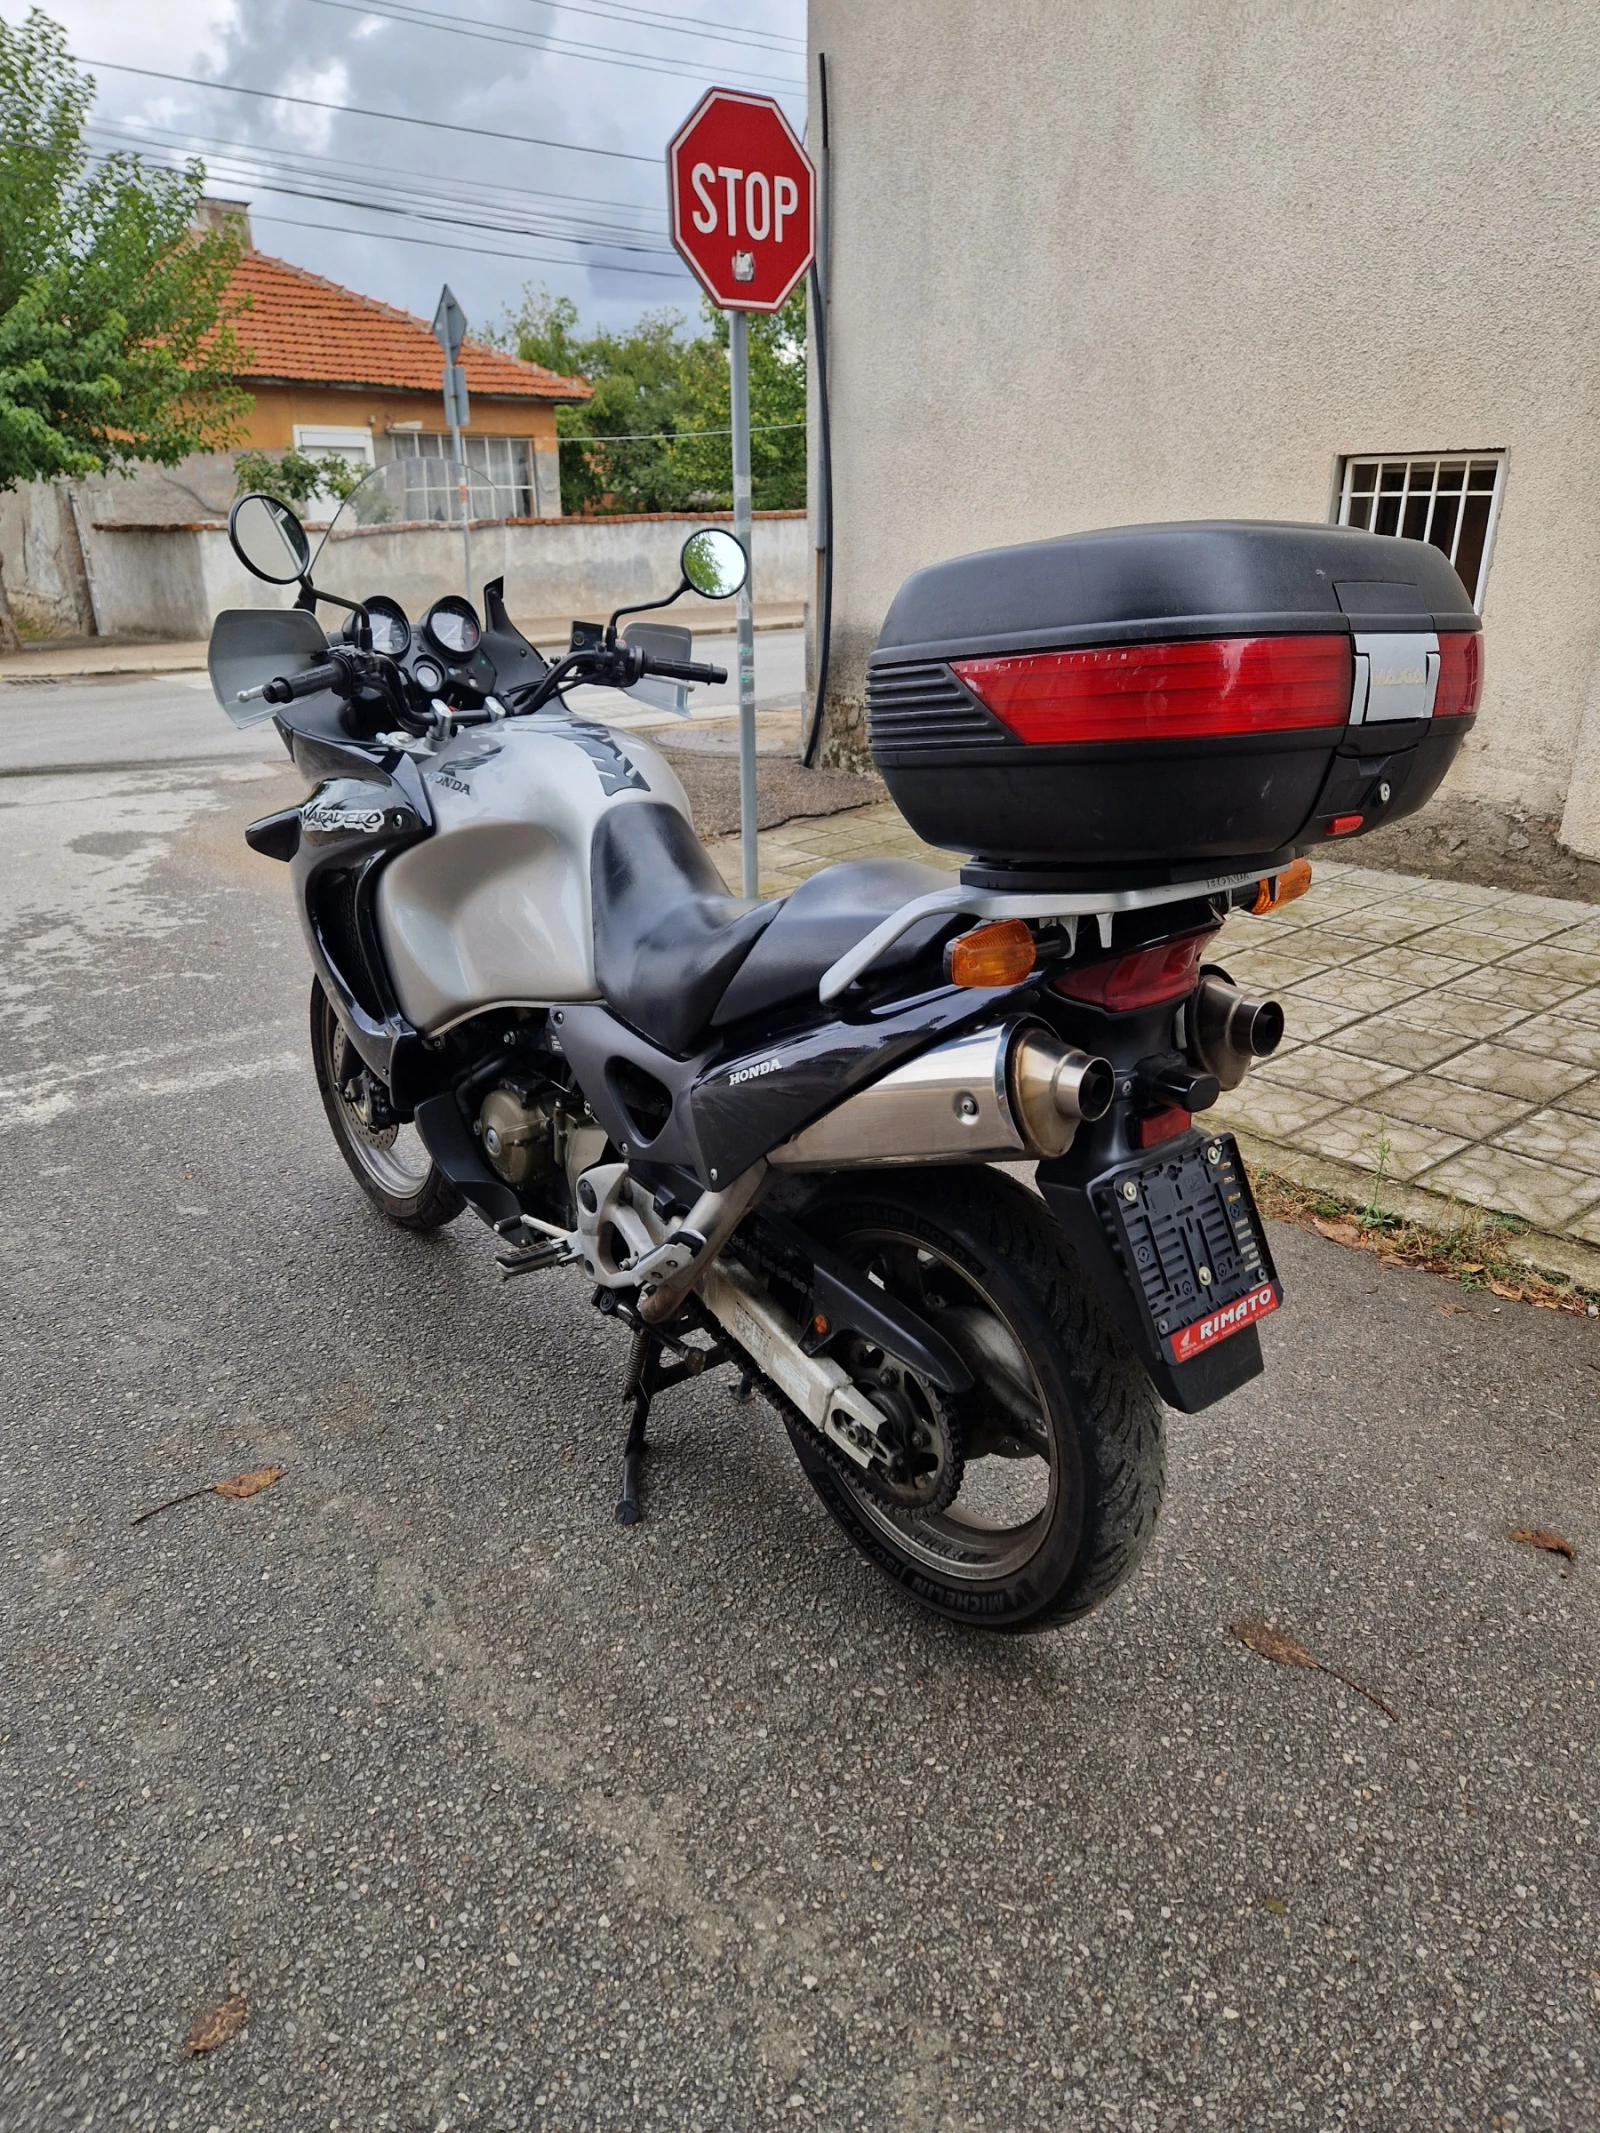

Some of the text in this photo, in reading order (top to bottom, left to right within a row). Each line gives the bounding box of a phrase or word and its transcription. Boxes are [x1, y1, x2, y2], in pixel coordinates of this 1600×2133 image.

[691, 162, 799, 243] STOP
[1057, 653, 1128, 665] SYSTEM
[424, 771, 471, 796] HONDA
[302, 803, 382, 830] VARADERO
[1206, 873, 1252, 889] HONDA
[729, 1058, 783, 1086] HONDA
[919, 1222, 965, 1260] ROAD
[1200, 1288, 1272, 1341] RIMATO
[852, 1526, 901, 1576] 150/70
[911, 1576, 1005, 1613] MICHELIN
